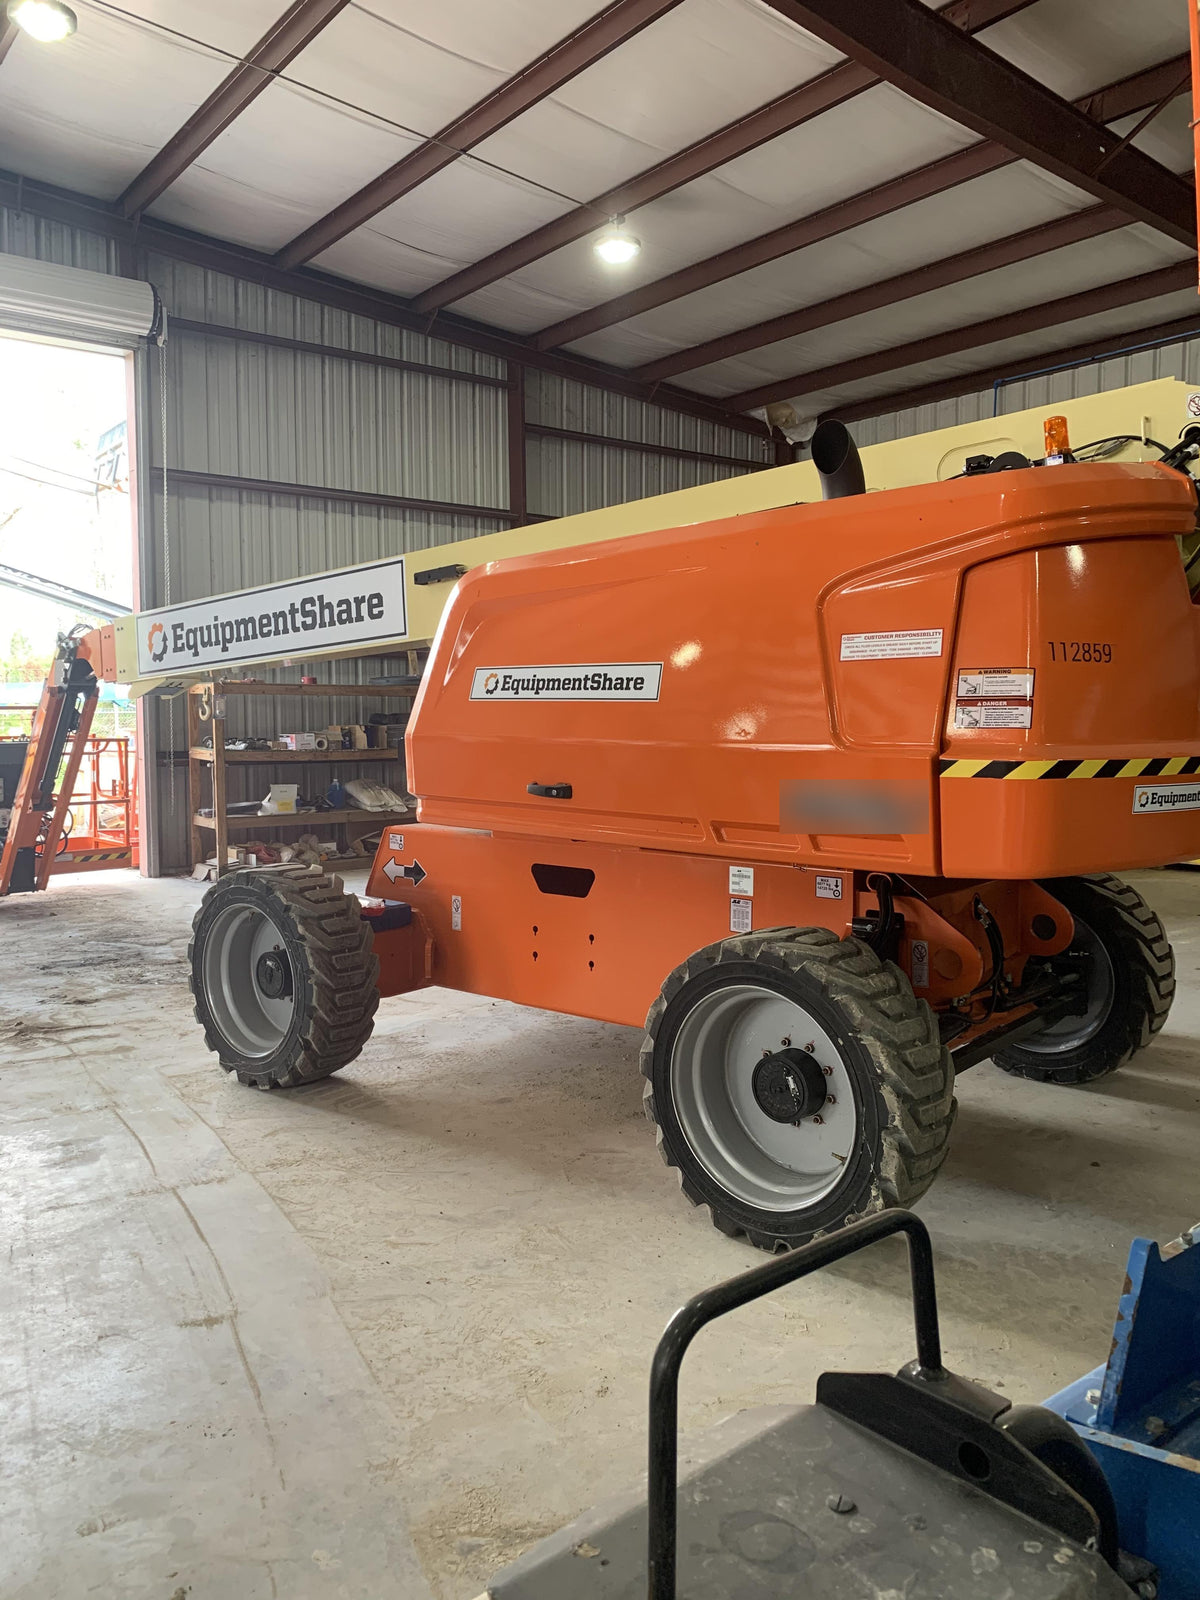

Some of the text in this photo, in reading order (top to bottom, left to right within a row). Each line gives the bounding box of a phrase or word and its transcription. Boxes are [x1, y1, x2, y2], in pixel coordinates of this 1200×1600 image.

[171, 591, 384, 657] EquipmentShare
[895, 631, 942, 639] RESPONSIBILITY
[1048, 641, 1112, 663] 112859
[501, 672, 645, 695] EquipmentShare
